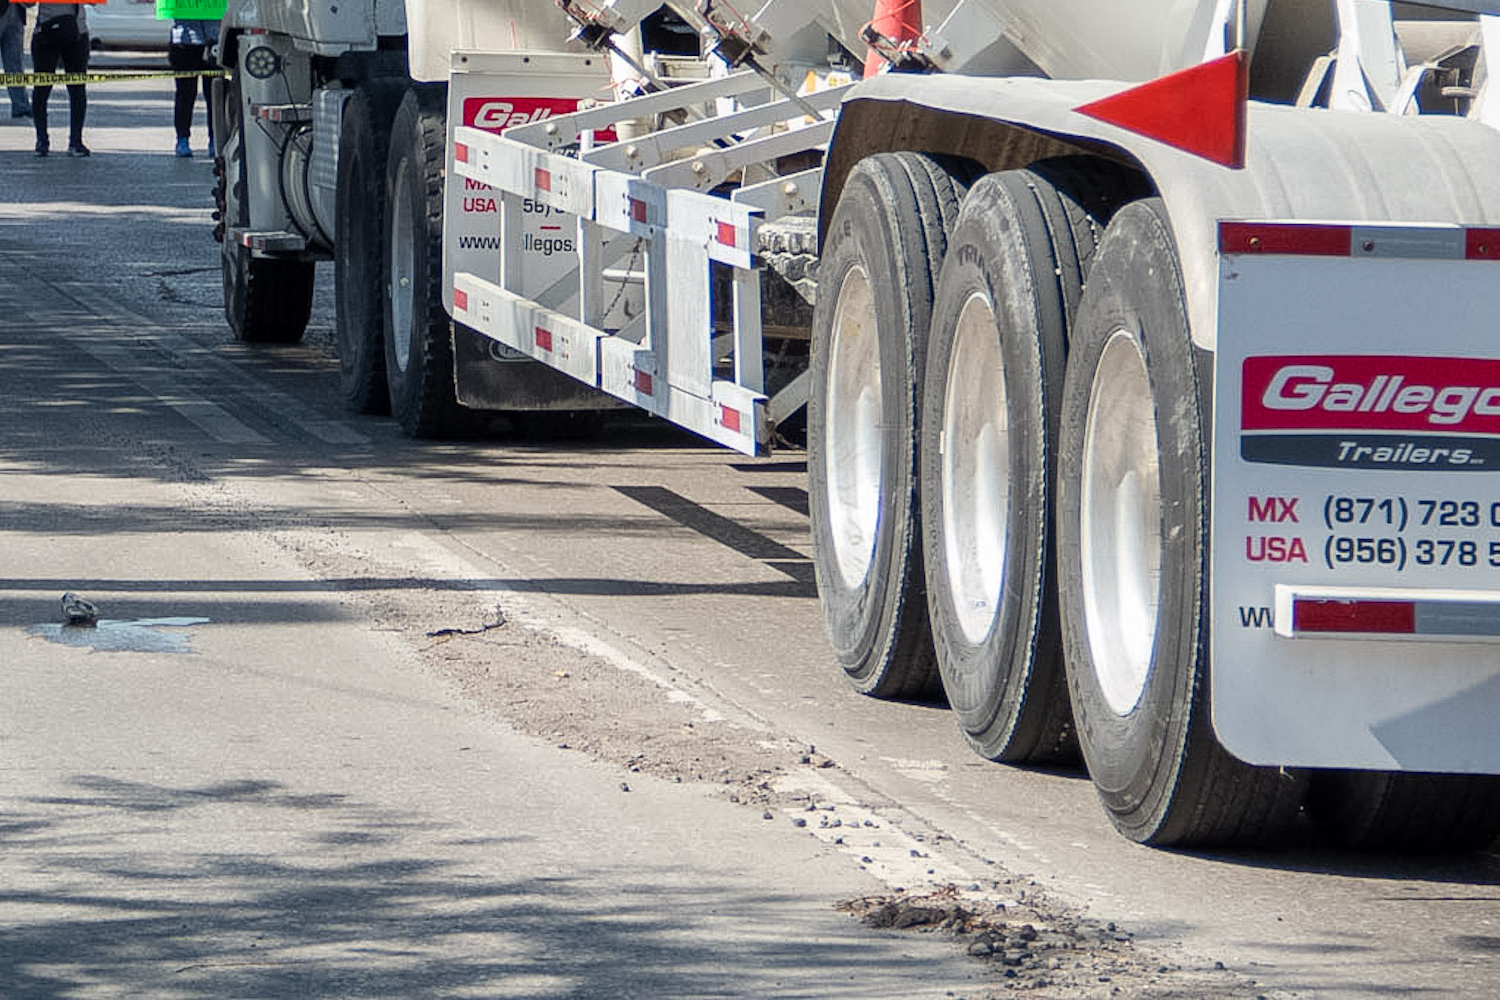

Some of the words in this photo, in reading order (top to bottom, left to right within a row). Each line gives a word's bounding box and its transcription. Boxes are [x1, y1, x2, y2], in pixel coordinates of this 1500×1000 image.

[463, 198, 497, 212] USA
[1337, 441, 1472, 464] Trailers
[1248, 497, 1299, 522] MX
[1324, 495, 1408, 532] (871)
[1418, 500, 1480, 526] 723
[1246, 536, 1308, 563] USA
[1325, 535, 1407, 571] (956)
[1416, 540, 1477, 566] 378
